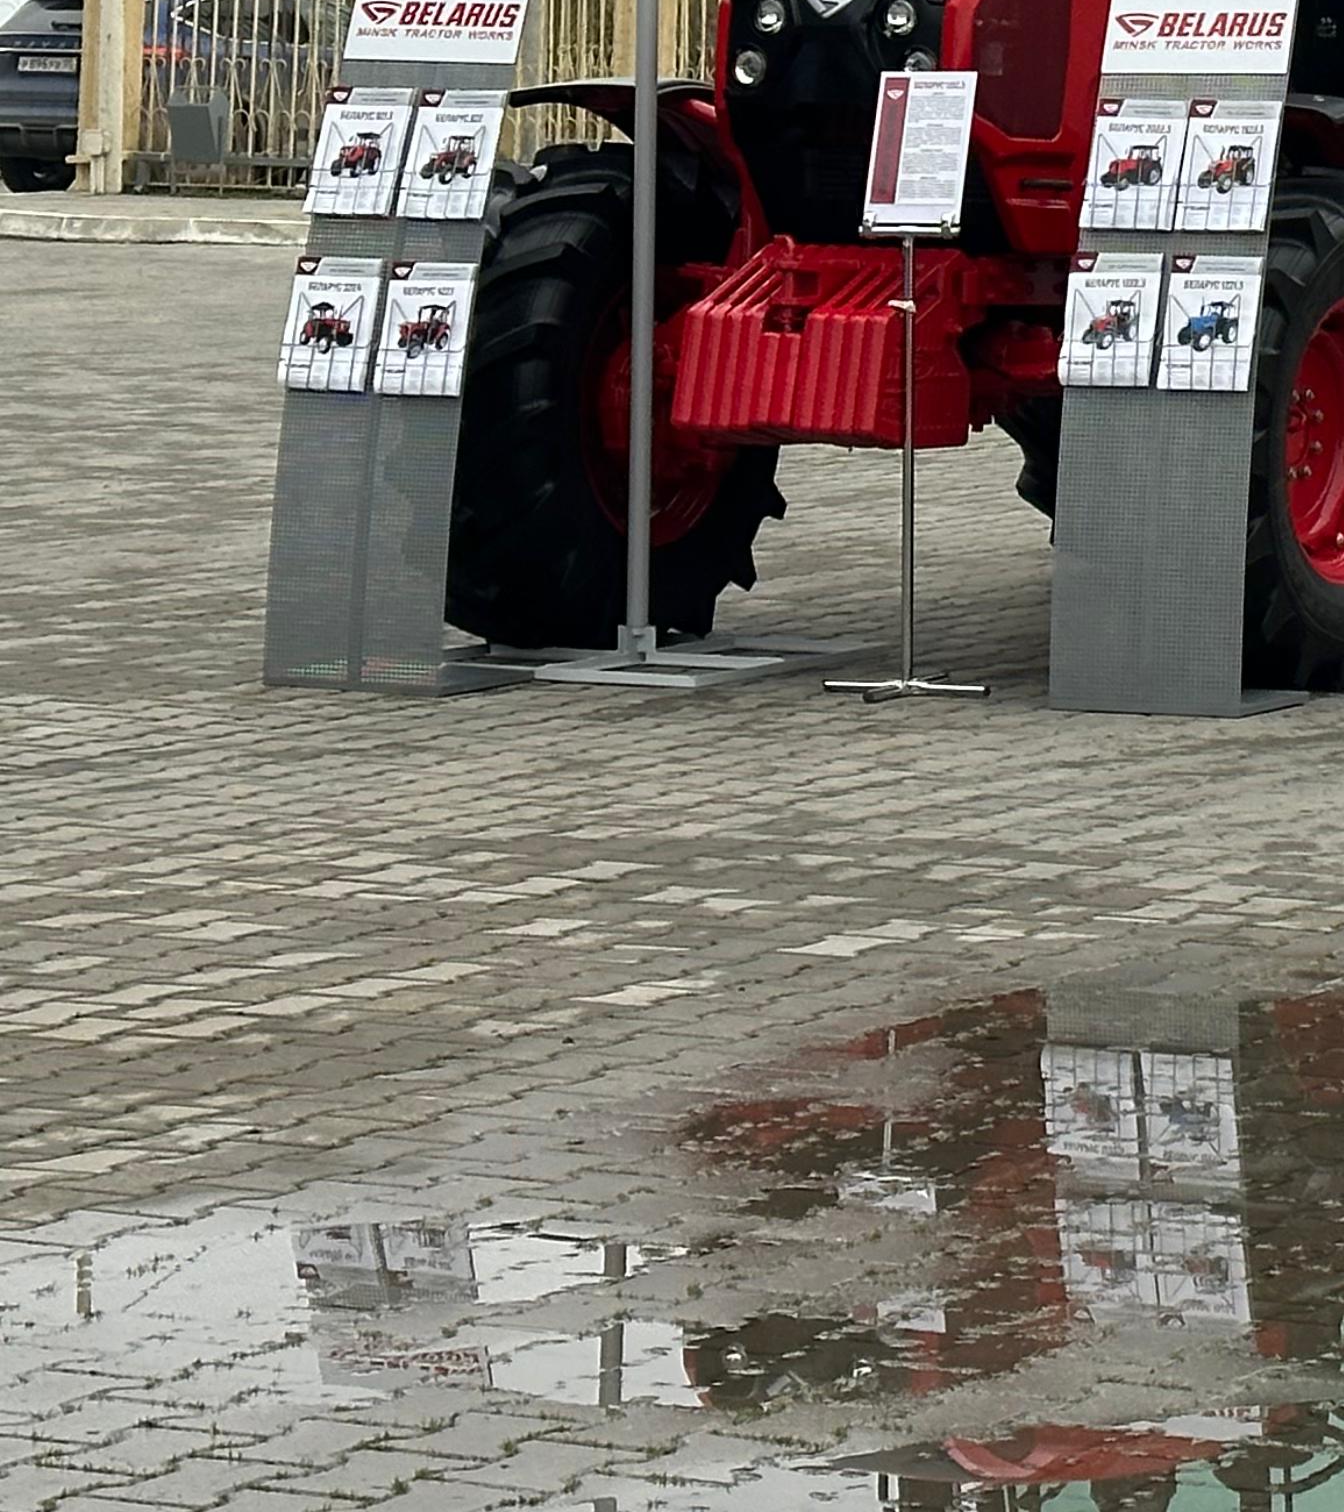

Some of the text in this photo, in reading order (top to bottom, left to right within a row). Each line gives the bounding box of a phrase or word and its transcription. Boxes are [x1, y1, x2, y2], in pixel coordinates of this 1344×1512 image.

[399, 1, 521, 28] BELARUS
[356, 27, 514, 41] MINSK TRACTOR WORKS
[1157, 12, 1288, 38] BELARUS
[1112, 40, 1283, 50] MINSK TRACTOR WORKS
